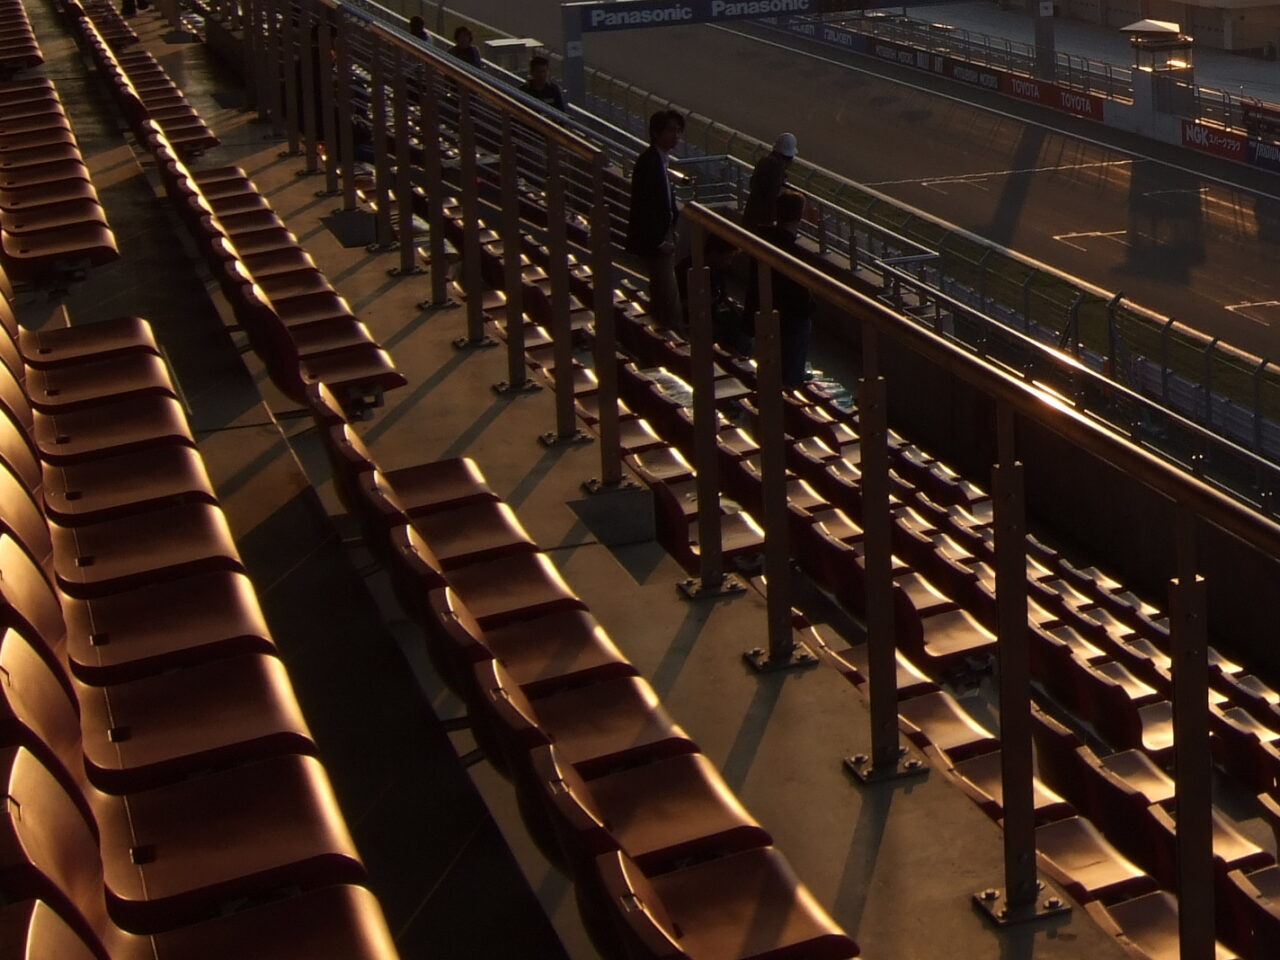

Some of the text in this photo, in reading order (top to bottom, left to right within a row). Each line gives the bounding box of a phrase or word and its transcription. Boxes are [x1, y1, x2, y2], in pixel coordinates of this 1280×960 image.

[591, 4, 693, 27] Panasonic
[1011, 78, 1040, 100] TOYOTA
[1061, 91, 1092, 114] TOYOTA
[1185, 124, 1209, 146] NGK
